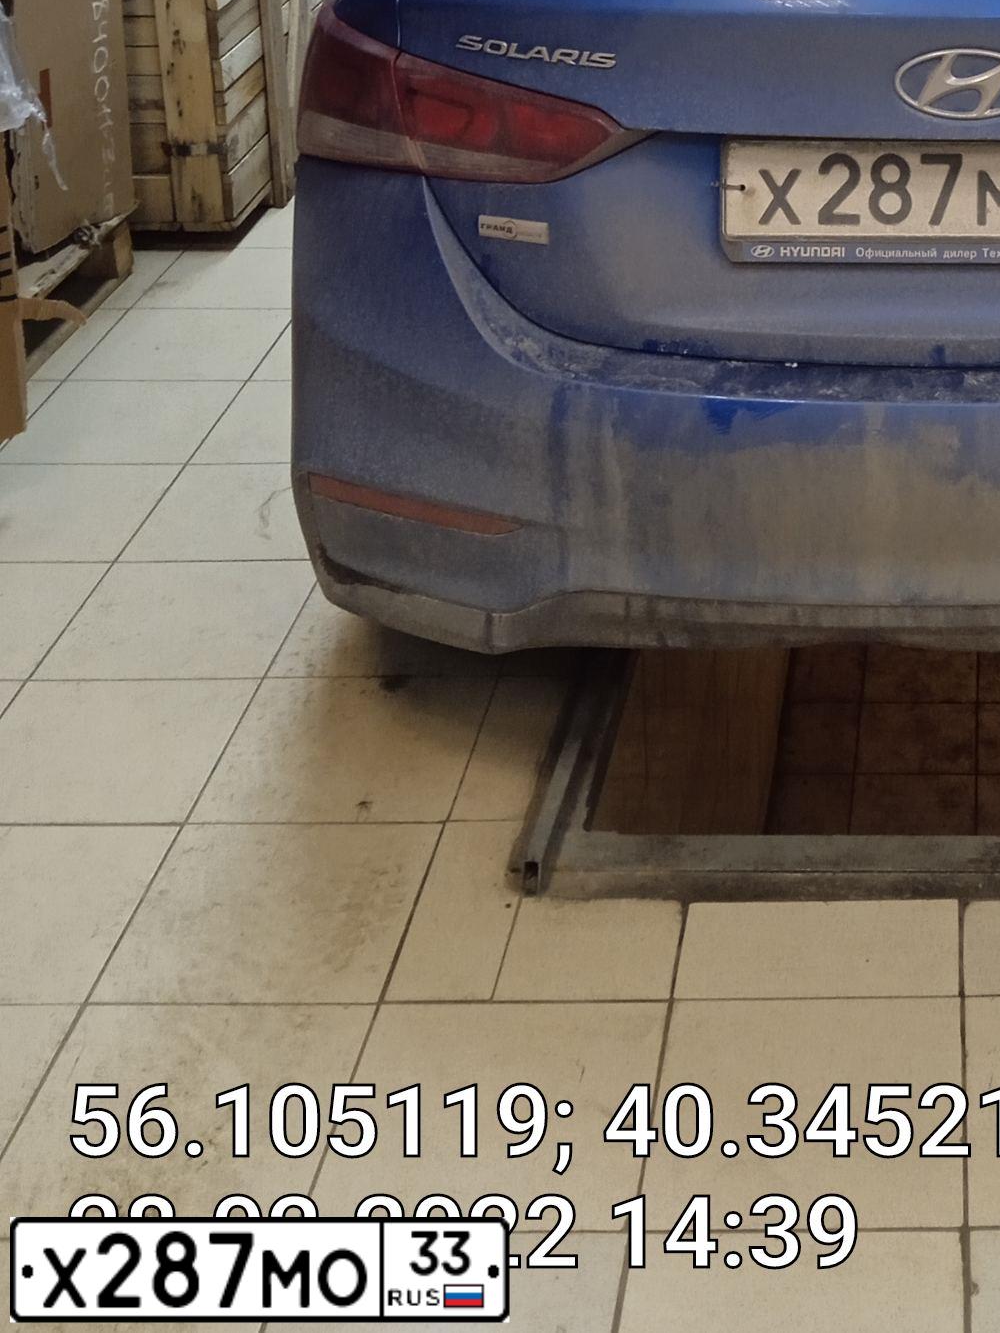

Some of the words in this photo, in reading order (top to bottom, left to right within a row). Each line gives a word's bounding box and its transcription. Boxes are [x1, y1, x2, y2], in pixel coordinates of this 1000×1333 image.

[456, 34, 617, 69] SOLARIS
[780, 246, 845, 257] HYUNDAI
[855, 247, 937, 259] Официальный
[943, 250, 977, 259] дилер
